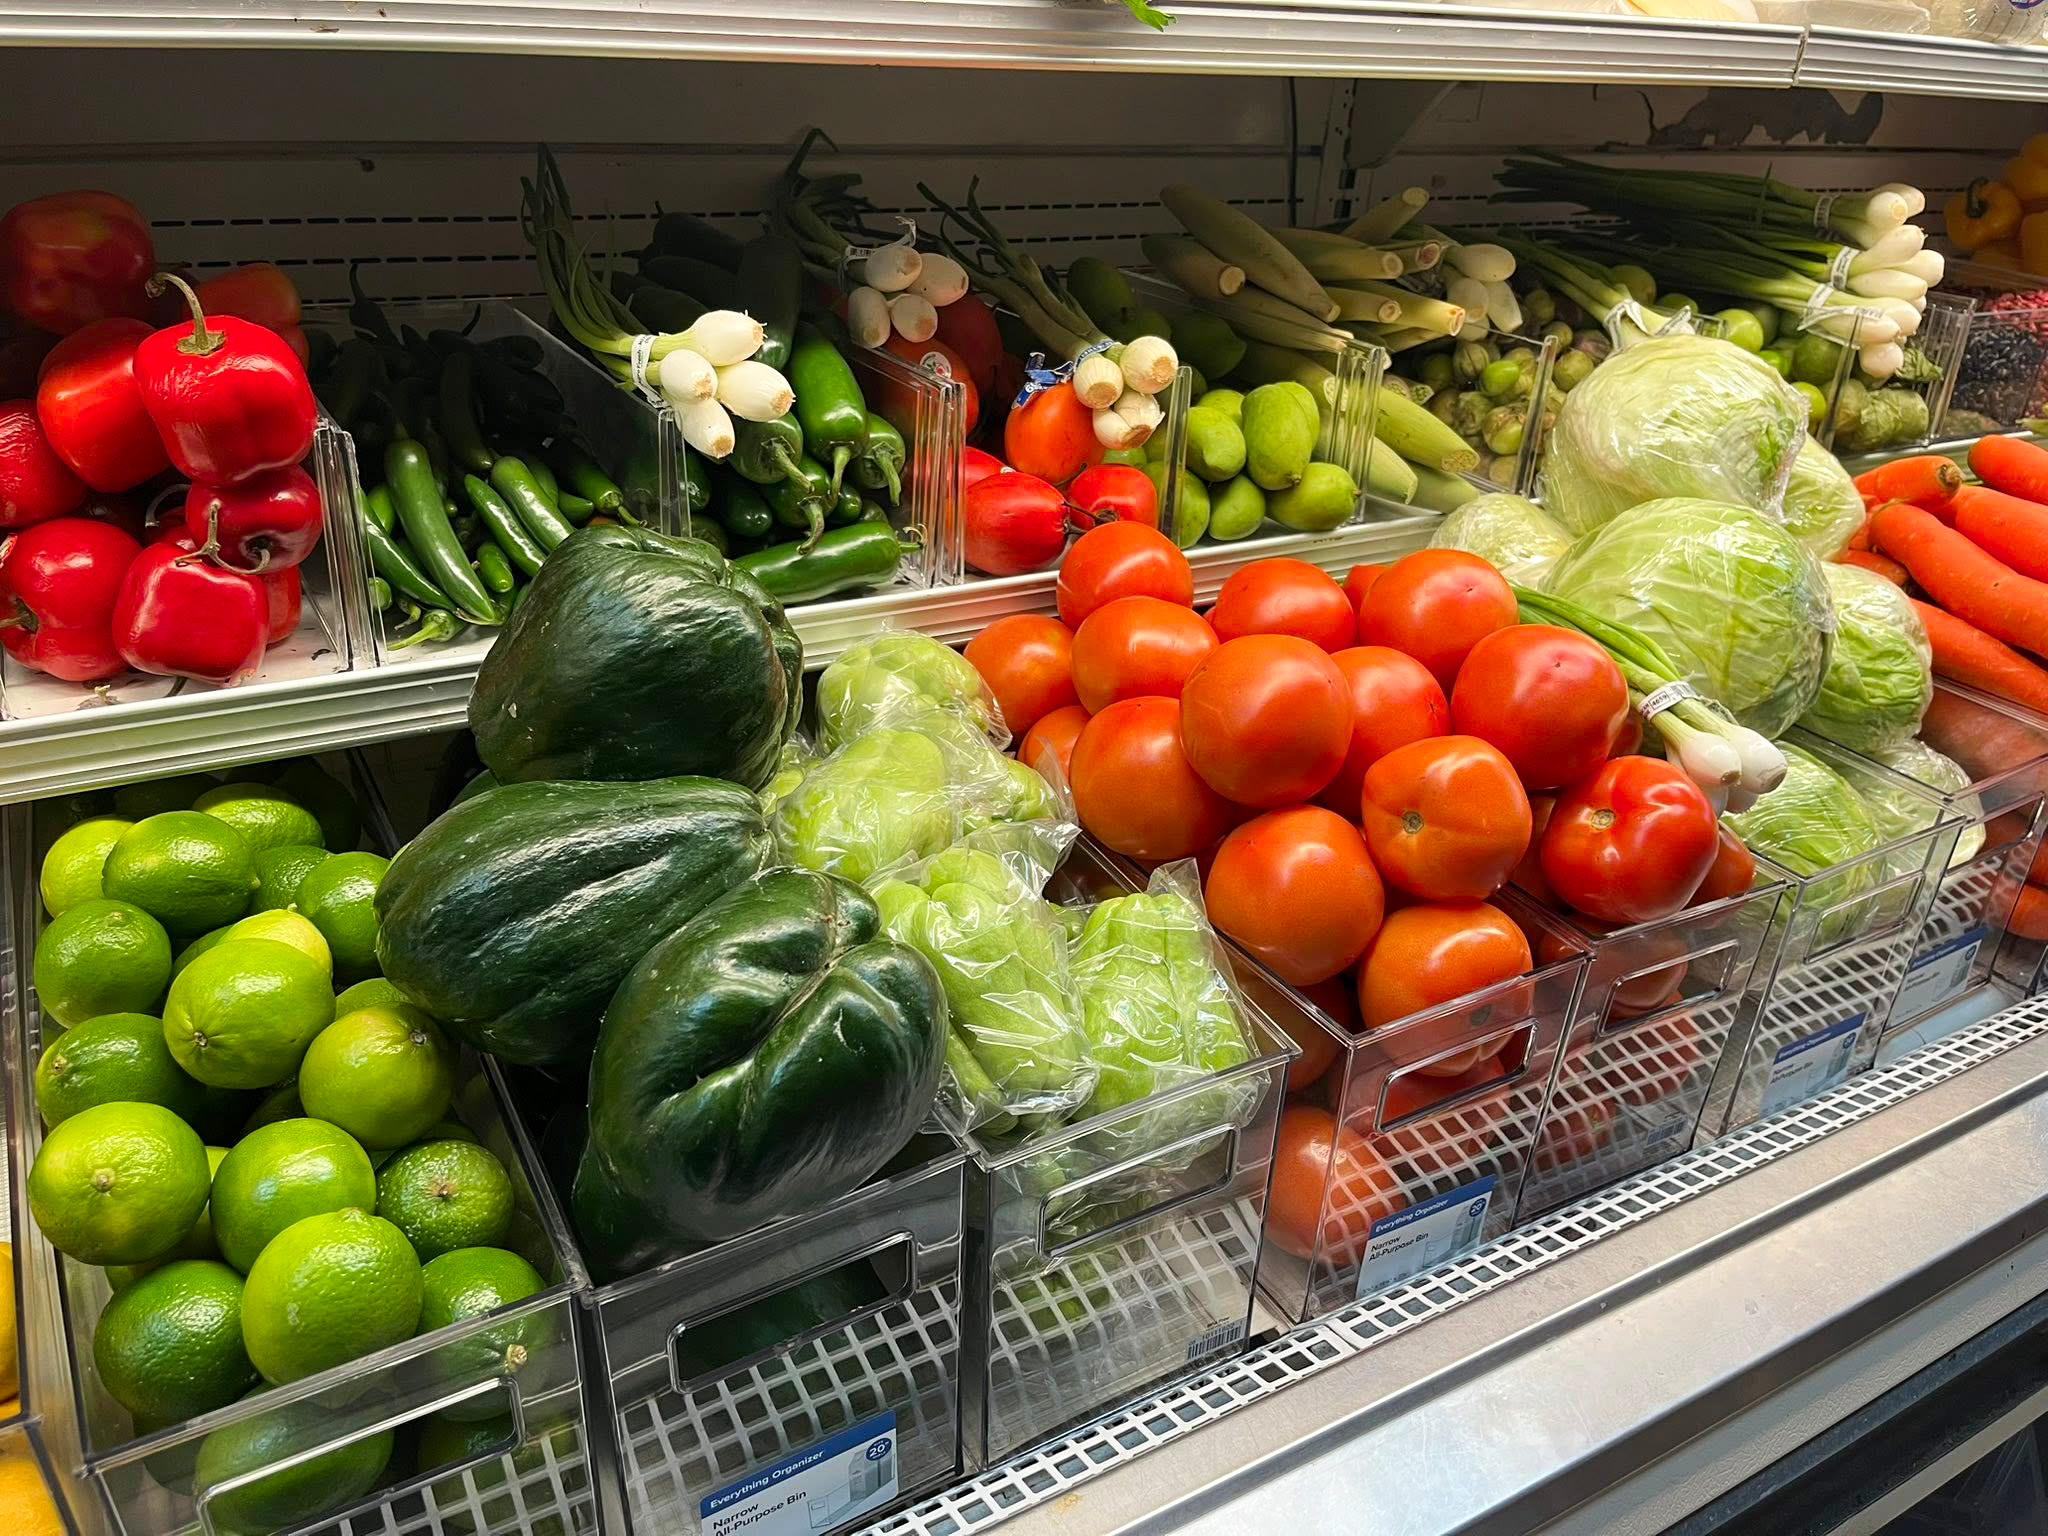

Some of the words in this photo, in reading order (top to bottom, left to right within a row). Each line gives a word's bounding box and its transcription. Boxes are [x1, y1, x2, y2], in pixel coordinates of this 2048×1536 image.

[1375, 1212, 1414, 1233] Everything
[1414, 1199, 1449, 1217] Organizer
[1368, 1239, 1415, 1262] All-Purpose
[1415, 1232, 1429, 1243] Bin
[1371, 1236, 1401, 1252] Narrow
[710, 1476, 769, 1509] Everything
[772, 1450, 824, 1479] Organizer
[713, 1503, 759, 1530] Narrow
[715, 1502, 784, 1536] All-Purpose
[787, 1490, 807, 1505] Bin
